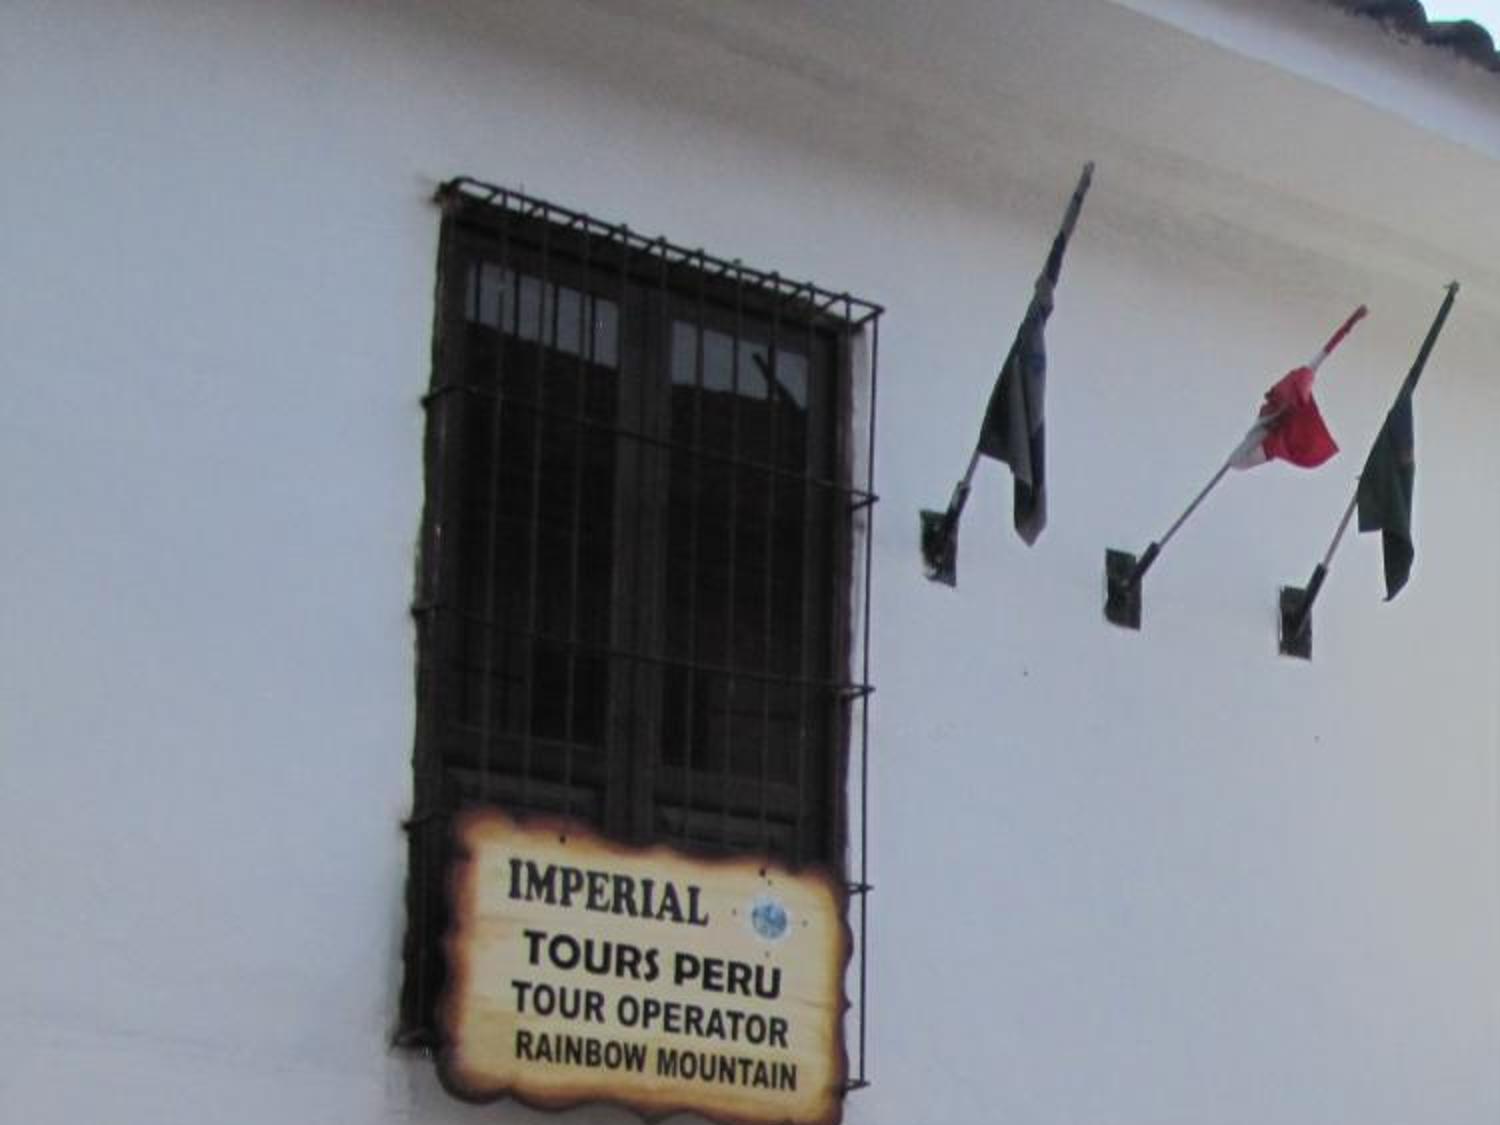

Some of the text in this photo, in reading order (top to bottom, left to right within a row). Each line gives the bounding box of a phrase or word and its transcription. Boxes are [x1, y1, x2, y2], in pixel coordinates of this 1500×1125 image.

[508, 858, 709, 927] IMPERIAL
[523, 930, 782, 1000] TOURS PERU
[511, 980, 788, 1048] TOUR OPERATOR
[515, 1031, 798, 1092] RAINBOW MOUNTAIN
